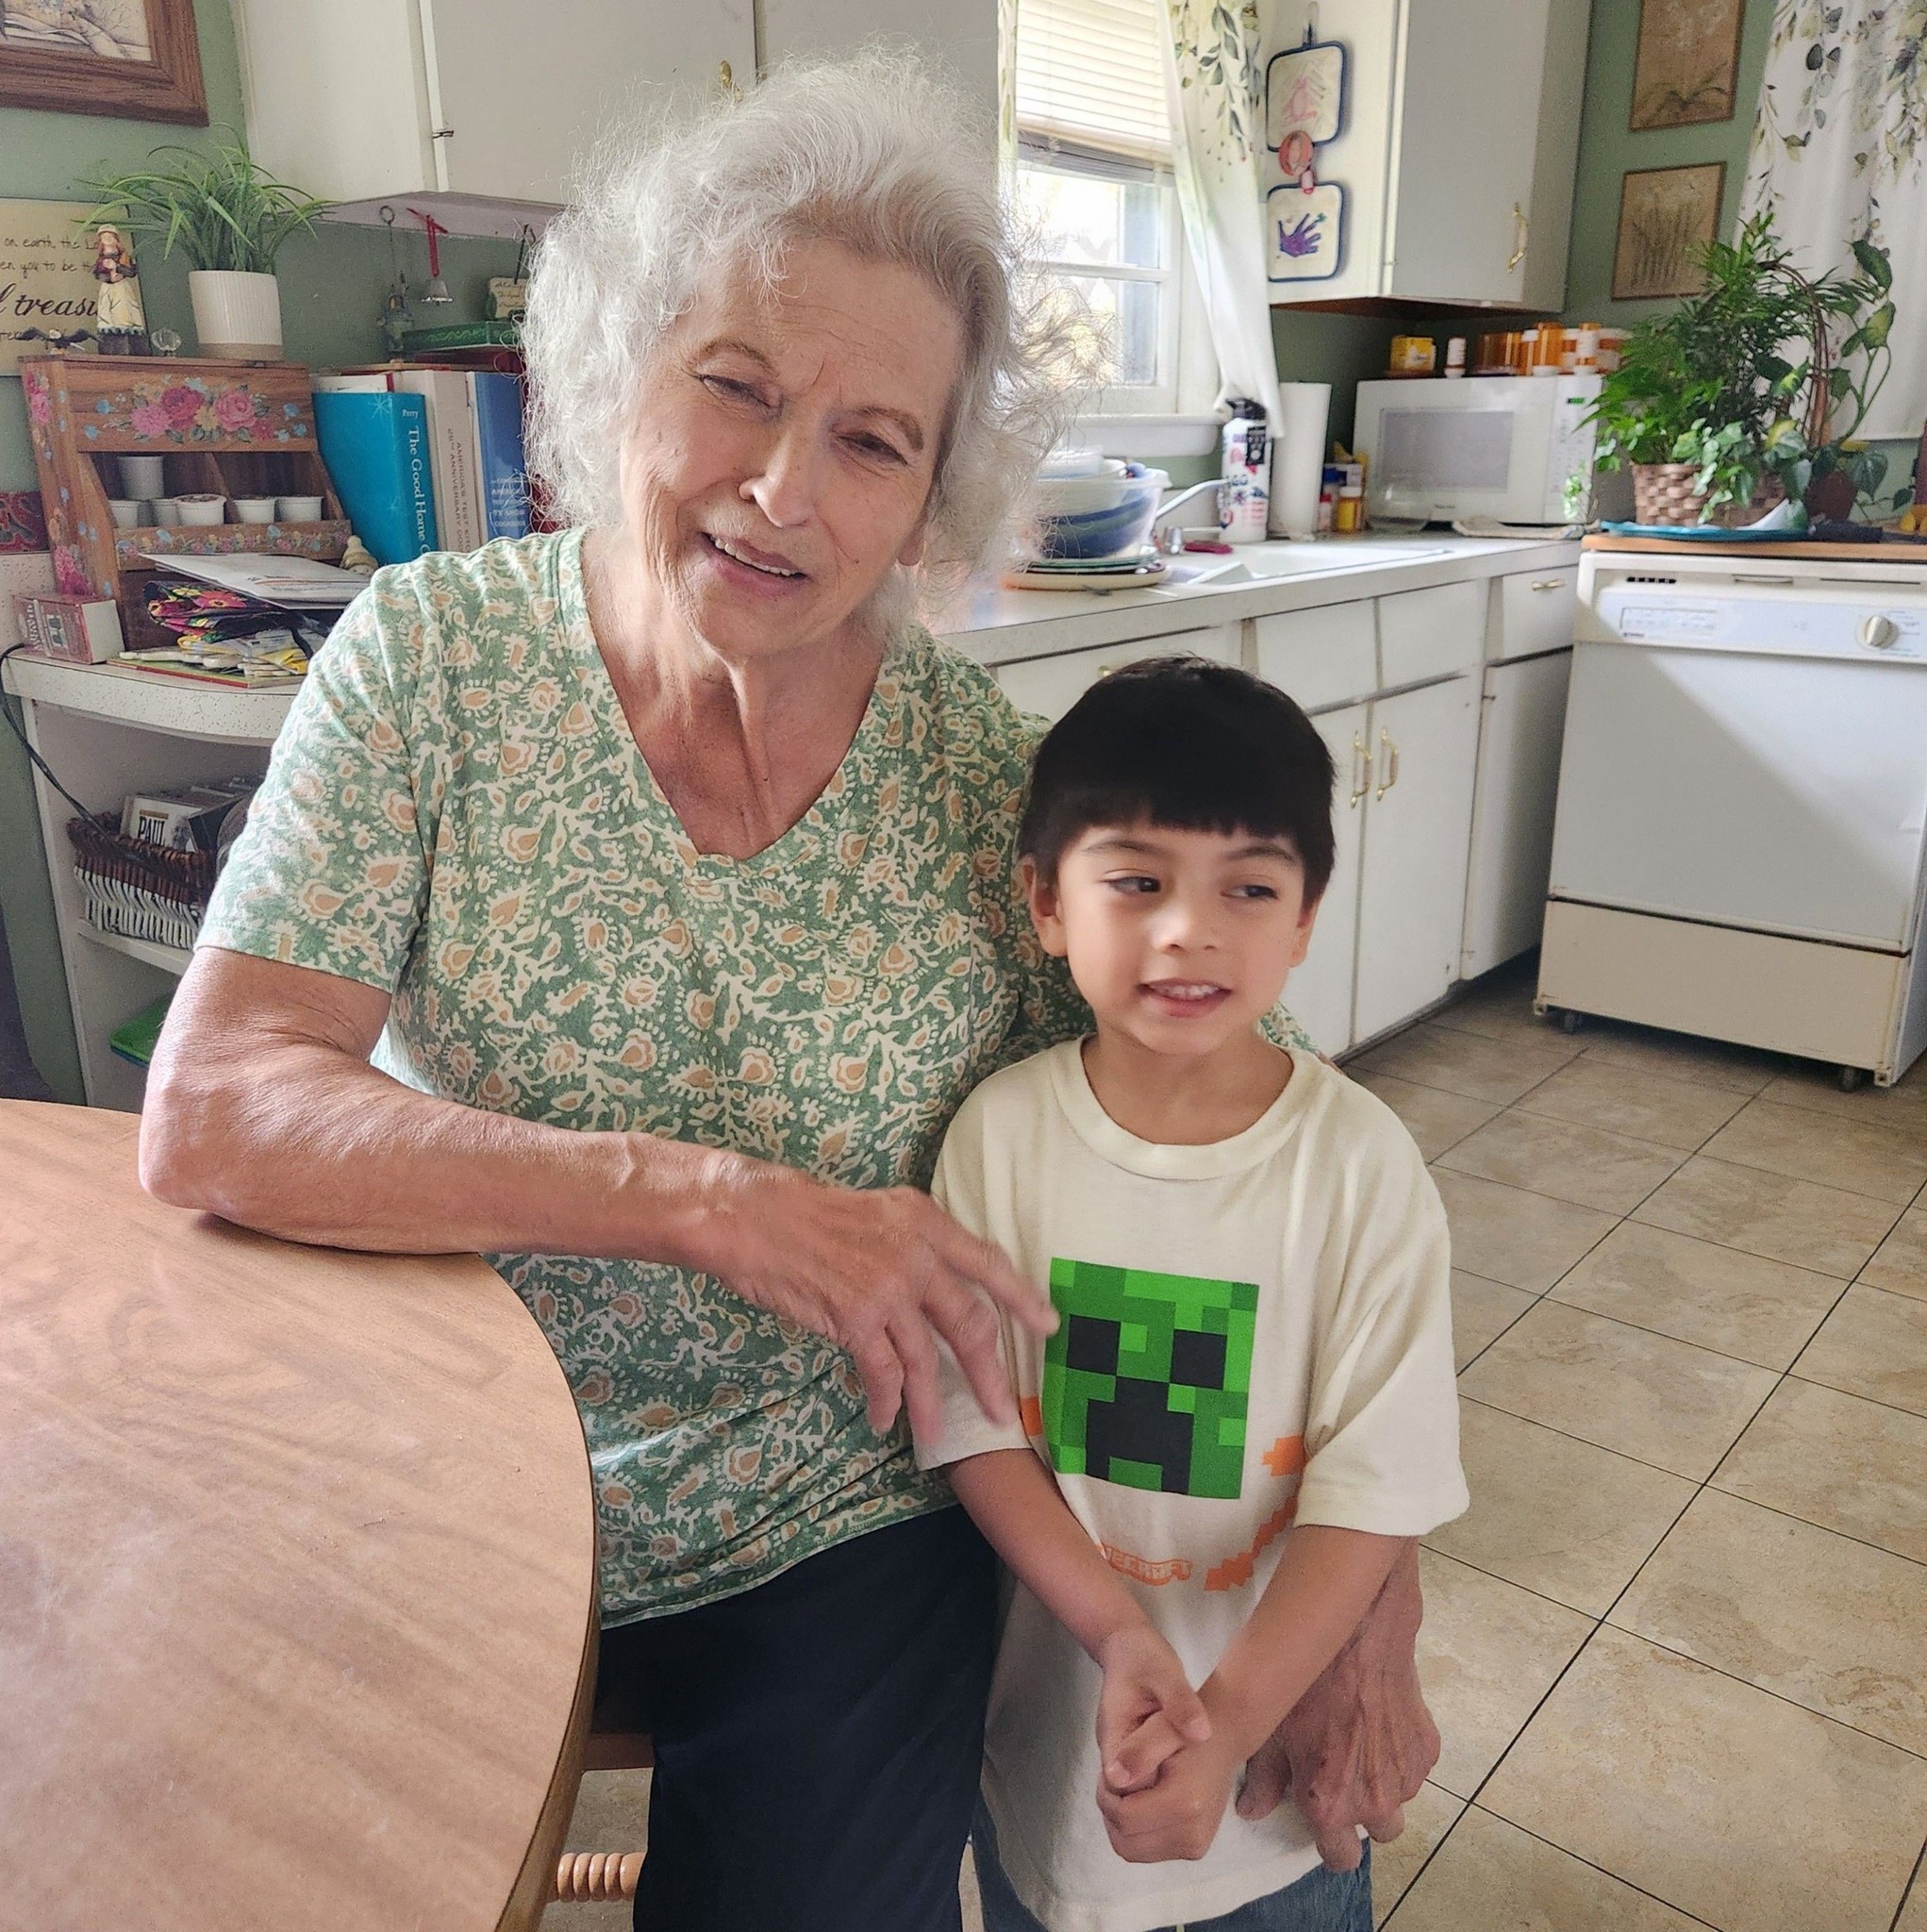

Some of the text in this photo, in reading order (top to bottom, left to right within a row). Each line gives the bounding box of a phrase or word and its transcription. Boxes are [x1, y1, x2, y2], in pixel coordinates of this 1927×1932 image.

[23, 234, 56, 249] earth
[21, 261, 39, 279] you
[42, 259, 56, 272] to
[62, 258, 77, 272] be
[408, 425, 420, 455] The
[411, 458, 424, 498] Good
[415, 501, 426, 541] Home
